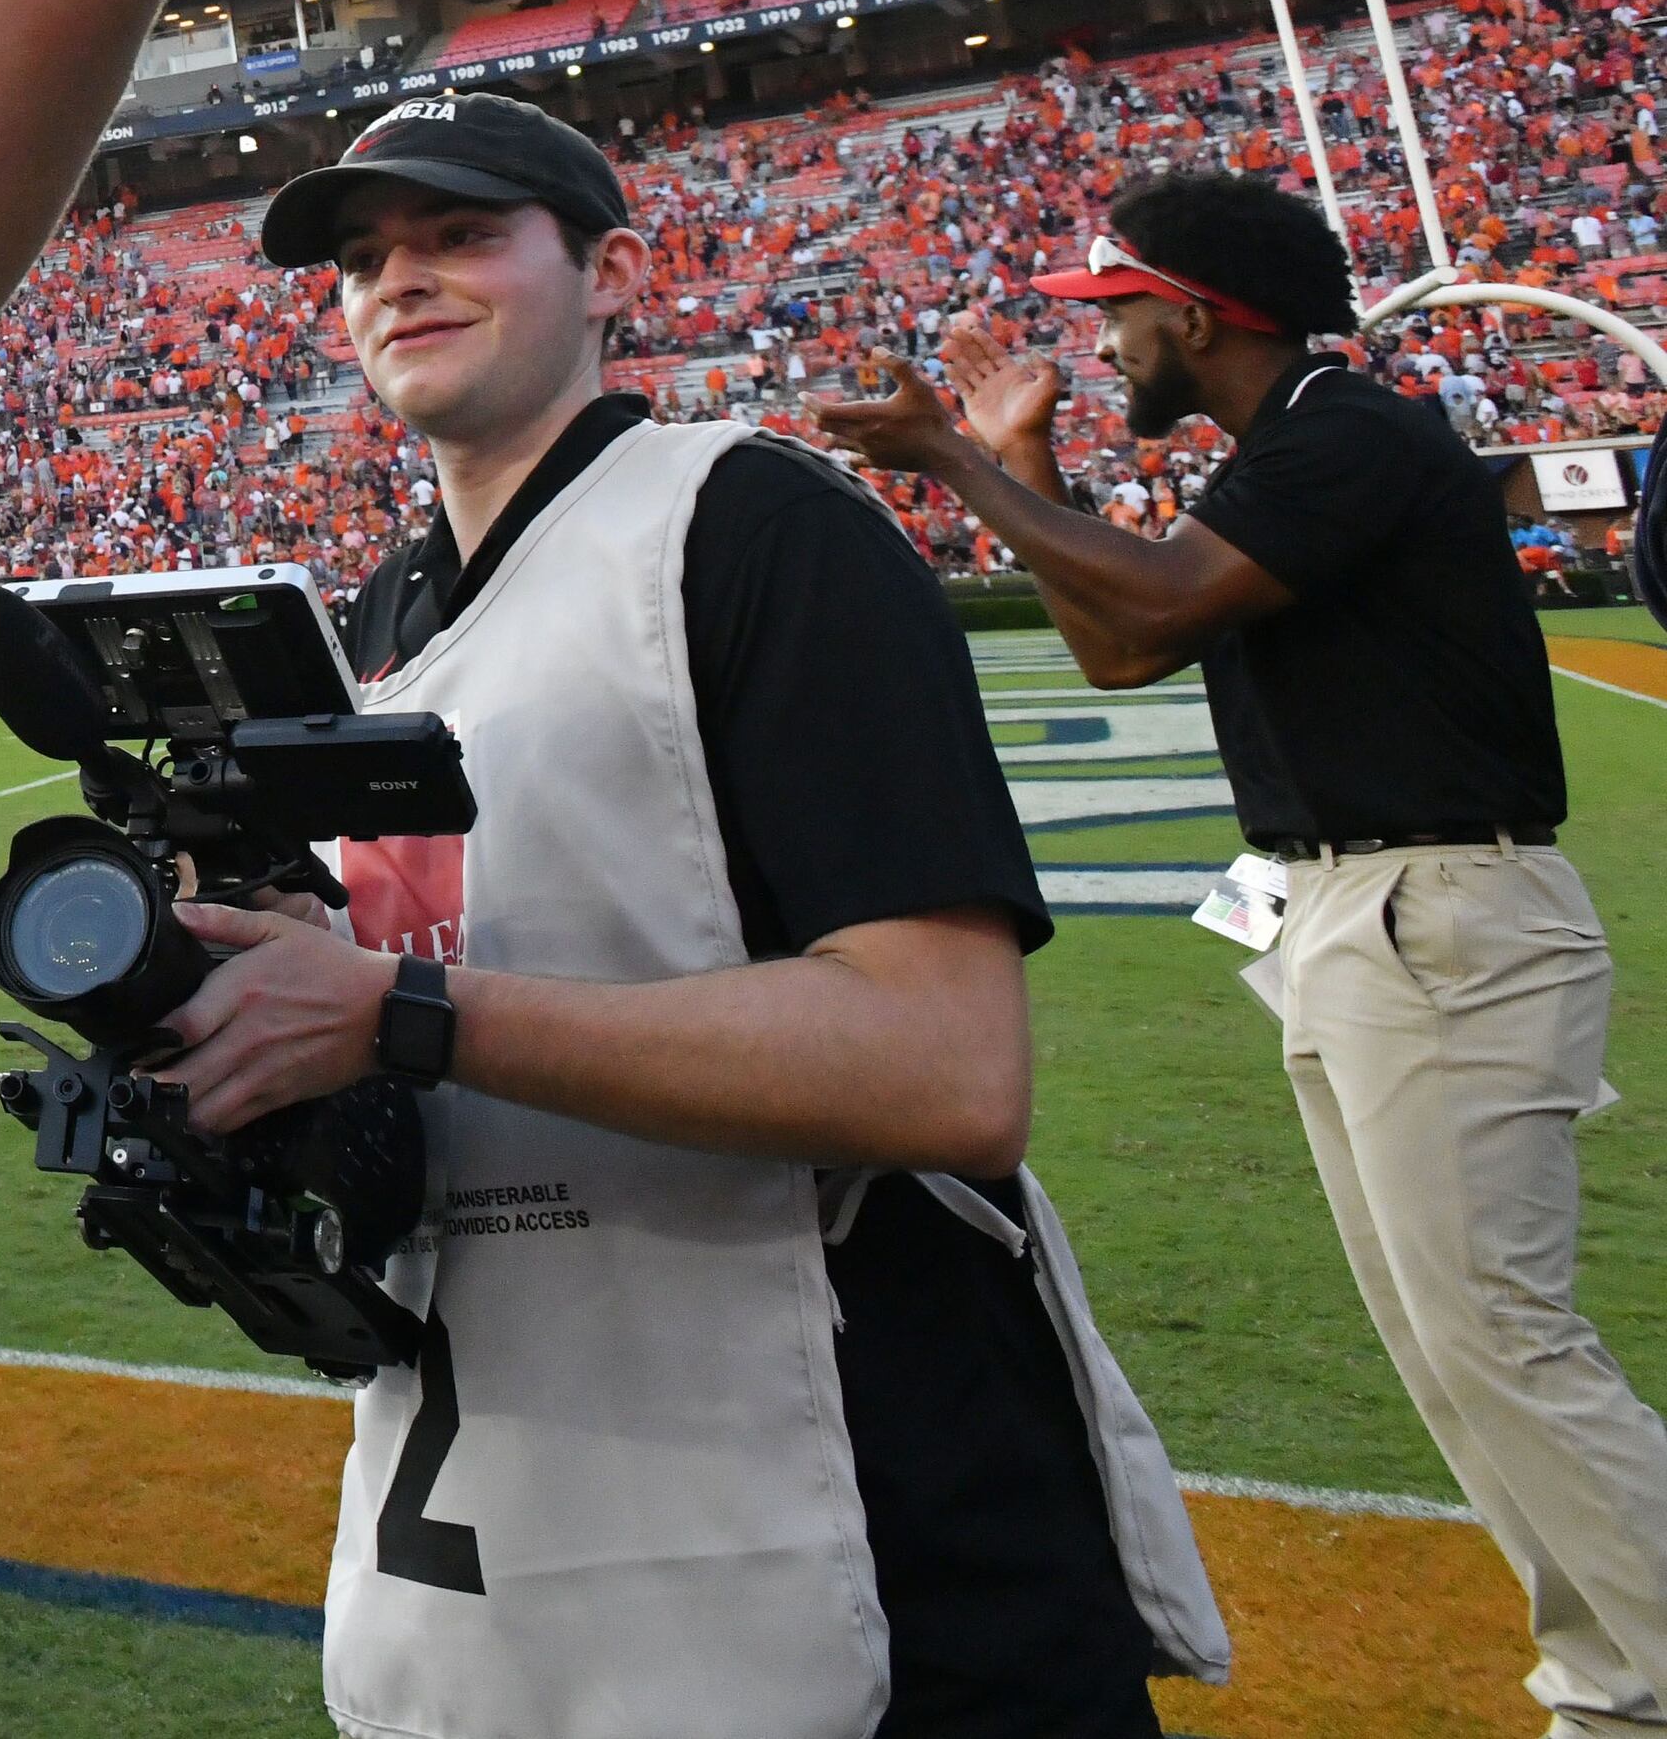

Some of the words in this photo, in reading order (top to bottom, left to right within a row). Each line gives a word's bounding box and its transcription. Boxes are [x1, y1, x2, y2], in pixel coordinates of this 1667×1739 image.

[254, 98, 288, 117] 2013
[352, 81, 389, 99] 2010
[400, 73, 436, 91] 2004
[449, 64, 485, 82] 1989
[497, 55, 535, 74] 1988
[547, 45, 586, 63] 1987
[599, 36, 638, 55] 1983
[651, 27, 691, 46] 1957
[704, 18, 747, 36] 1932
[759, 7, 802, 26] 1919
[369, 780, 419, 791] SONY
[515, 1209, 591, 1233] ACCESS
